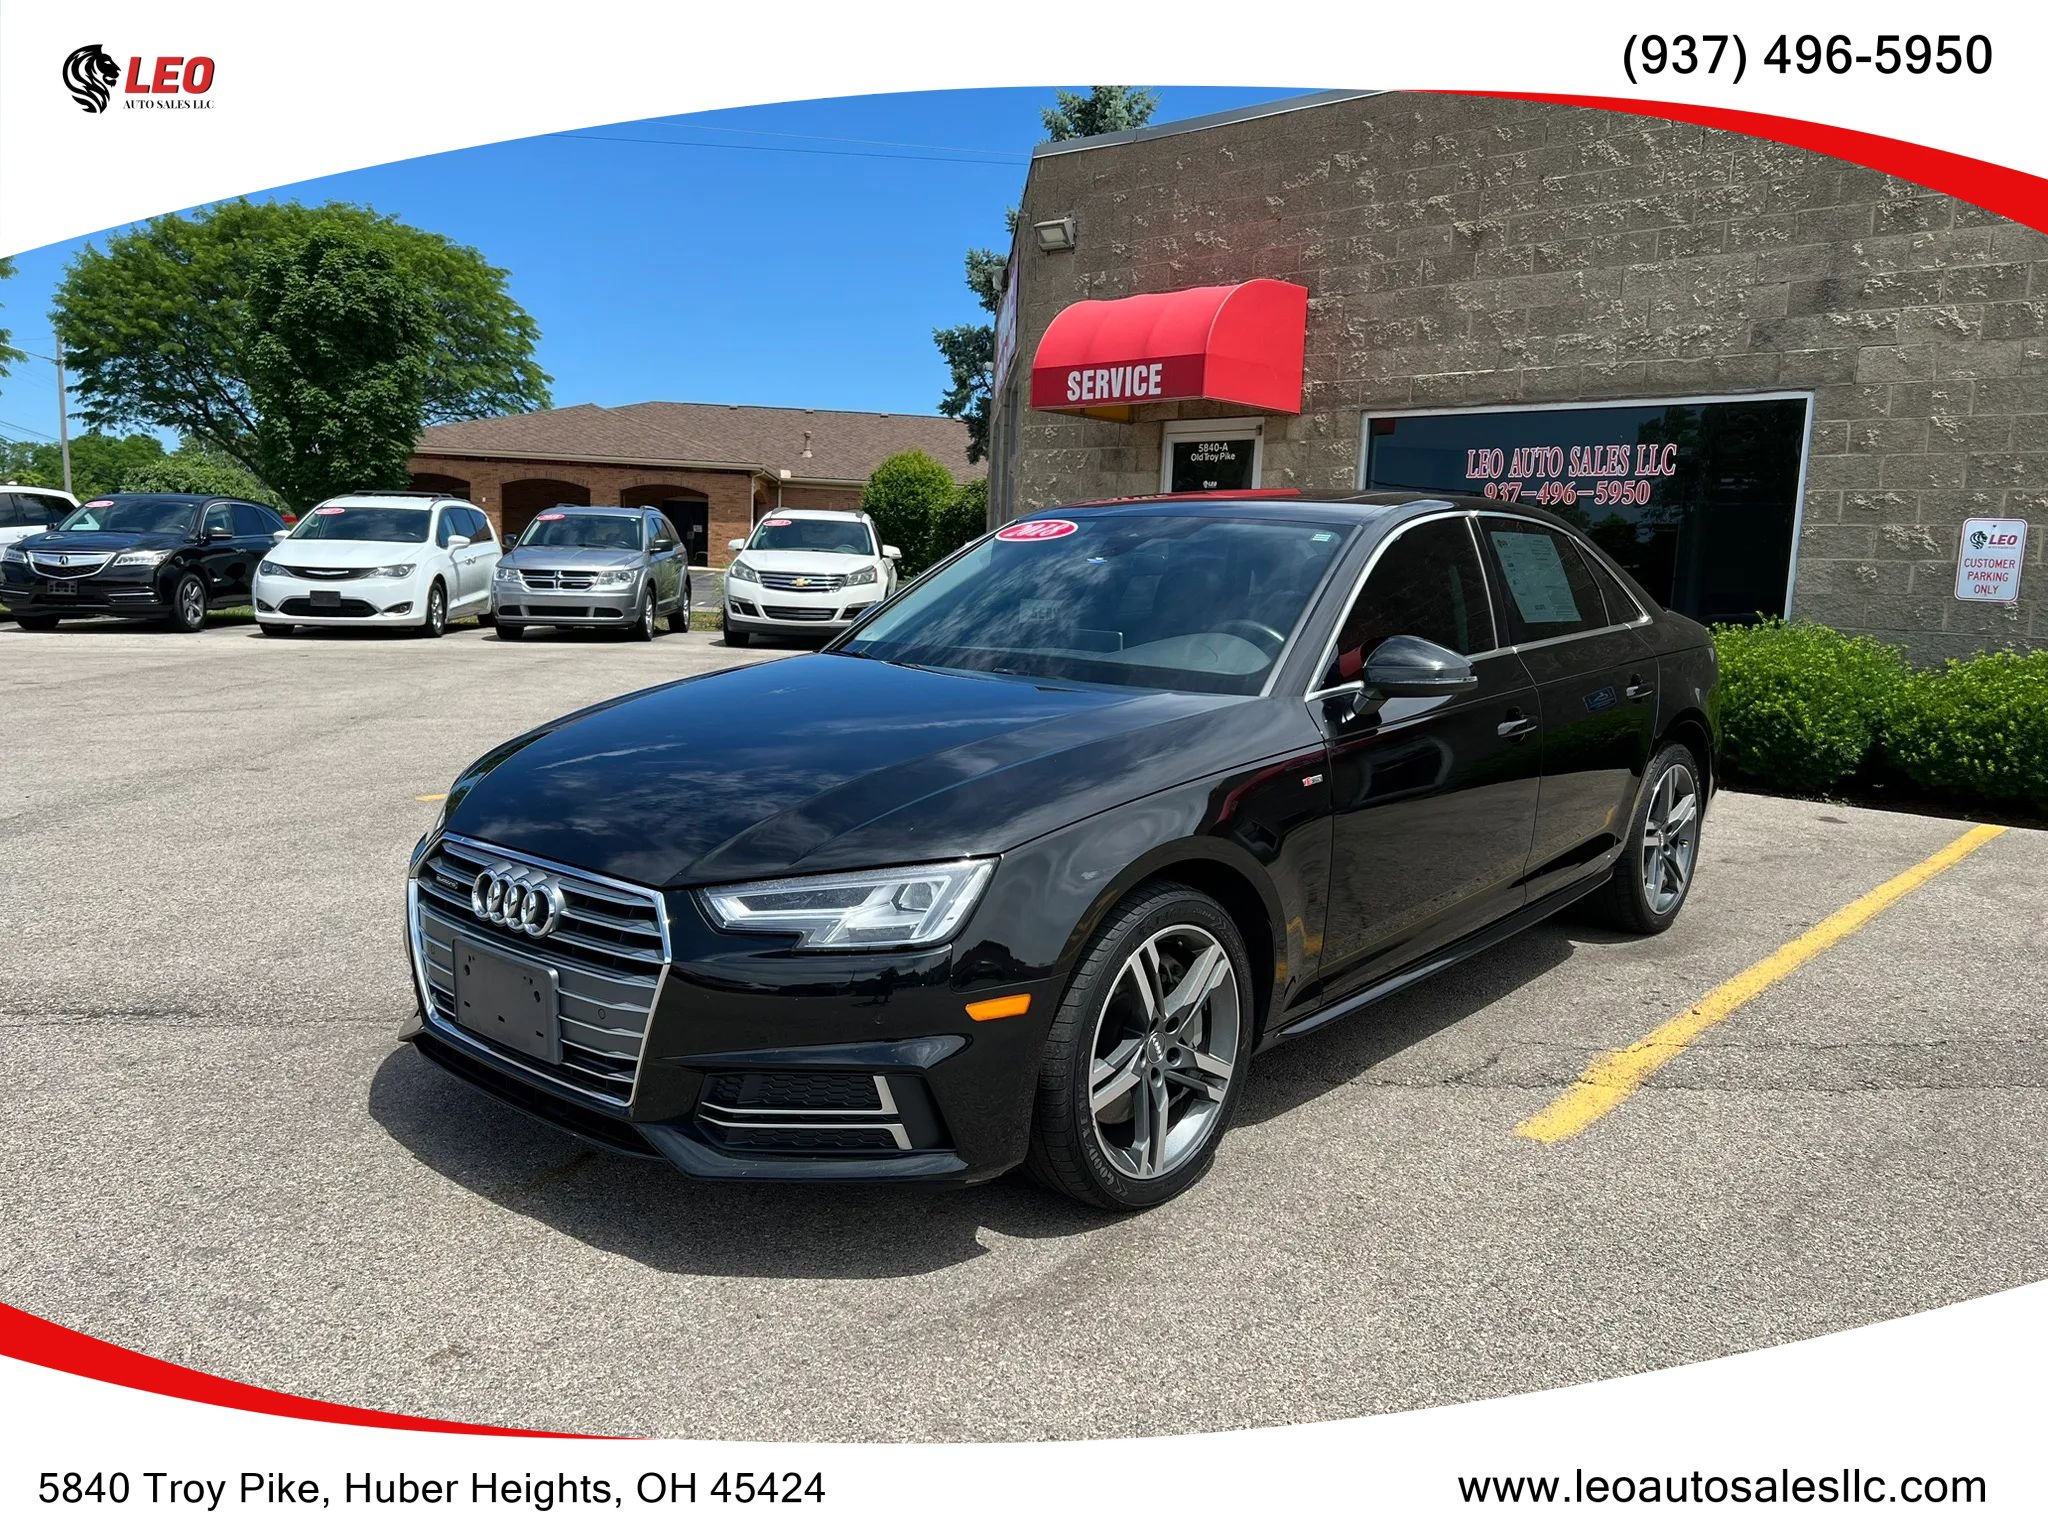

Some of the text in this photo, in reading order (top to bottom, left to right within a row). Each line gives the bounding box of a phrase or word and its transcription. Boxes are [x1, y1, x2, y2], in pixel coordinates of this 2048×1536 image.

[1067, 363, 1163, 402] SERVICE
[1198, 442, 1229, 453] 5840-A
[1190, 452, 1236, 463] Old Troy Pike
[1466, 443, 1678, 479] LEO AUTO SALES LLC
[1484, 480, 1651, 505] 937-496-5950
[1988, 534, 2018, 546] LEO
[1964, 558, 2016, 569] CUSTOMER
[1967, 571, 2009, 582] PARKING
[1974, 584, 1999, 595] ONLY
